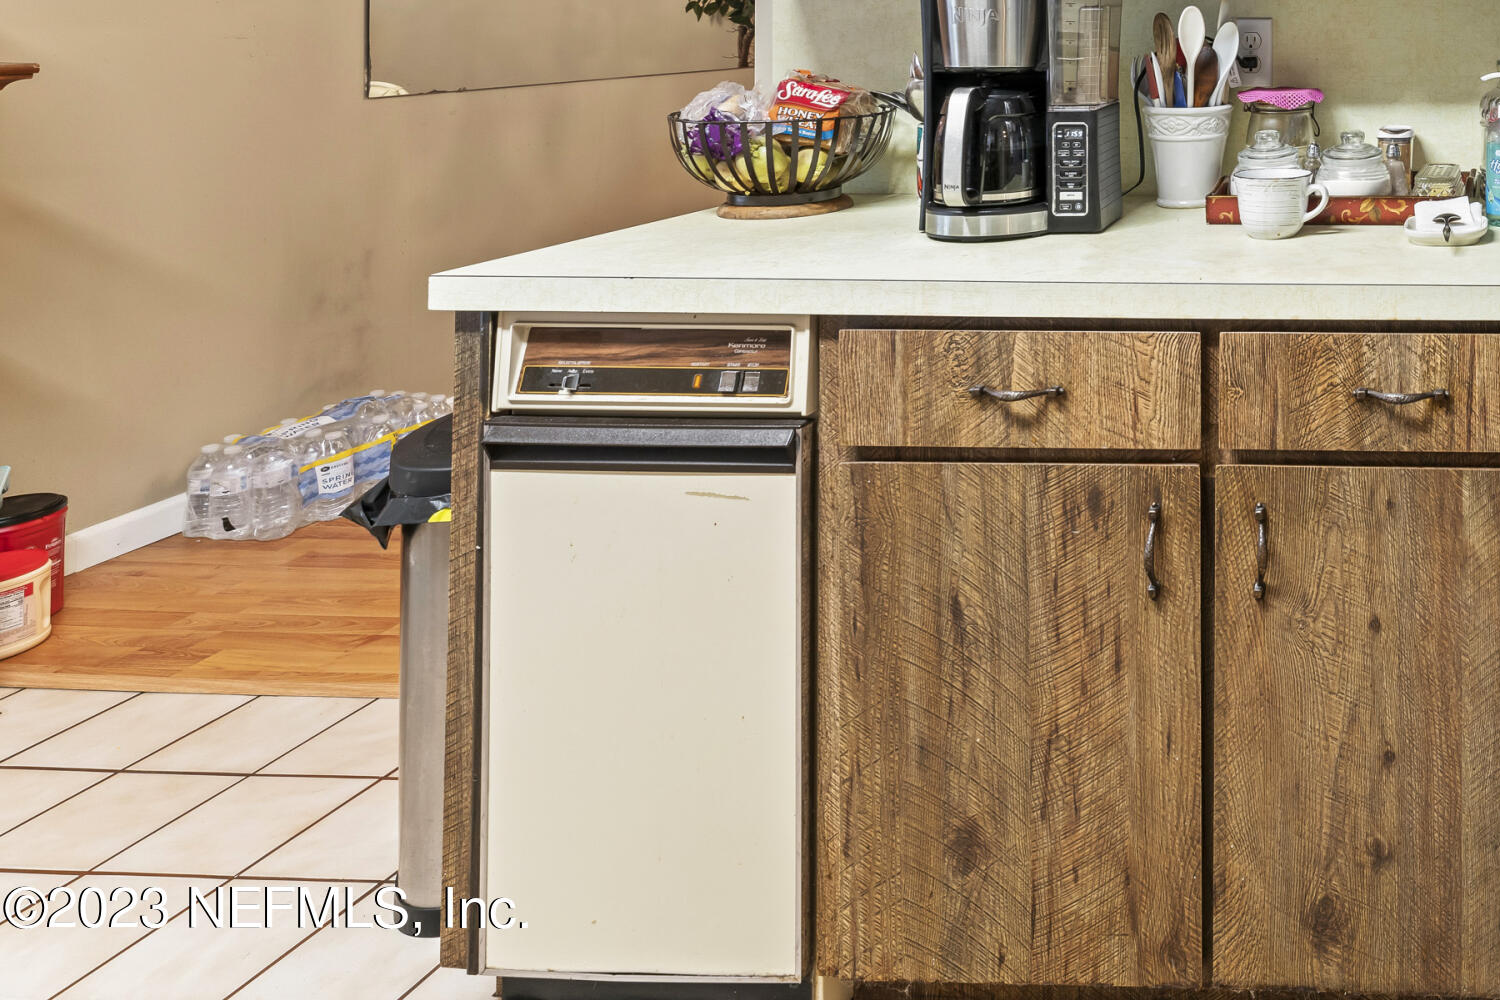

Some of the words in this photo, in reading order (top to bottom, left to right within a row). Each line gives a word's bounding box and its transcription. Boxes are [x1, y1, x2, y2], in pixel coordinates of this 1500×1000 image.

[953, 6, 1001, 27] NINJA
[777, 81, 818, 101] Sara
[811, 89, 841, 108] Lee
[778, 106, 824, 120] HONEY
[323, 477, 352, 490] WATER
